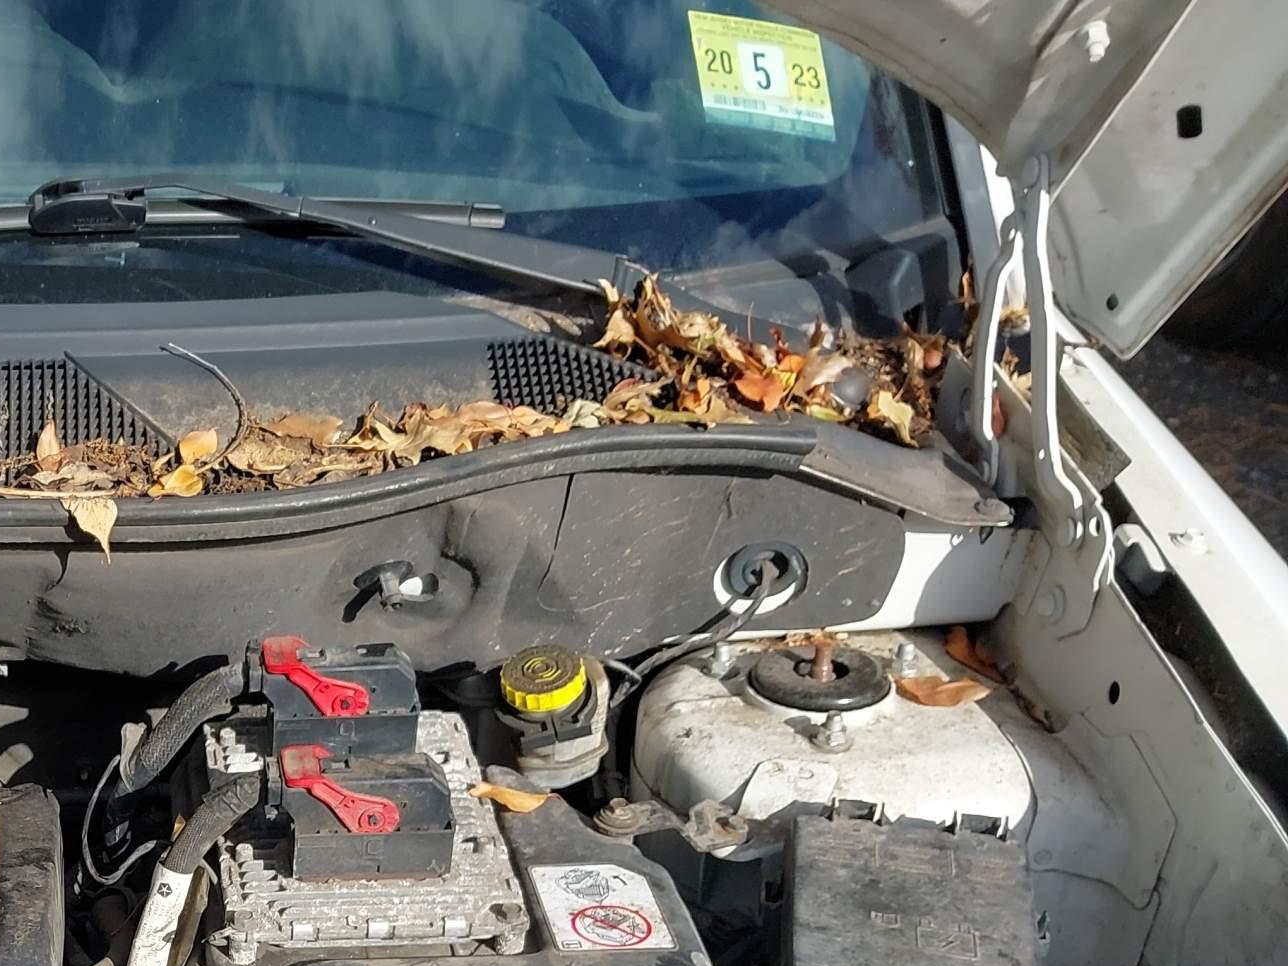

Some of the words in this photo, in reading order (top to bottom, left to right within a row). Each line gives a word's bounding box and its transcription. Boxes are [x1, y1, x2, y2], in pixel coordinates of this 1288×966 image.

[705, 48, 733, 74] 20
[752, 52, 771, 90] 5
[792, 63, 821, 89] 23
